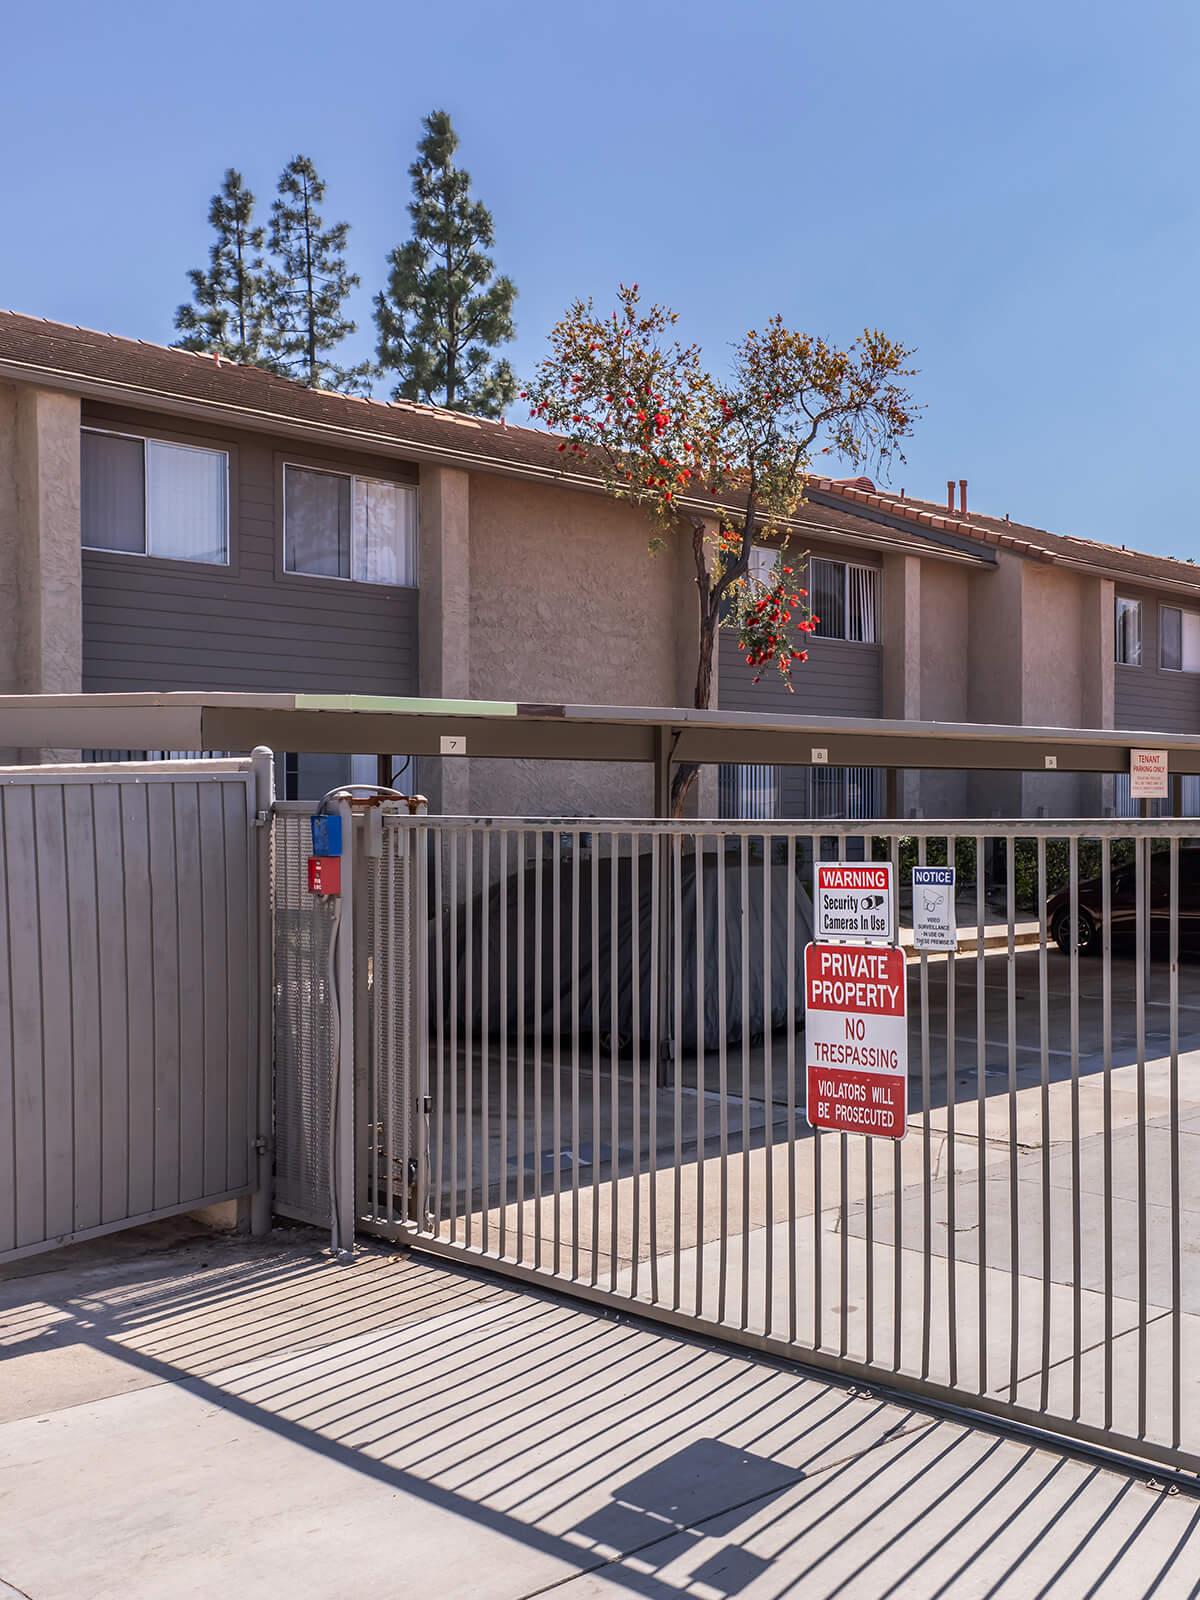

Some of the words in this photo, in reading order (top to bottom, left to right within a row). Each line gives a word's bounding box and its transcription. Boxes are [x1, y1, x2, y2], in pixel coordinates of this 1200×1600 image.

[450, 741, 456, 749] 7
[1139, 755, 1160, 763] TENANT
[822, 871, 886, 887] WARNING
[916, 871, 951, 883] NOTICE
[823, 894, 859, 914] Security
[823, 913, 859, 931] Cameras
[860, 915, 869, 930] In
[870, 916, 886, 932] Use
[821, 953, 889, 979] PRIVATE
[811, 980, 900, 1009] PROPERTY
[845, 1017, 866, 1041] NO
[814, 1042, 898, 1070] TRESPASSING
[818, 1079, 867, 1102] VIOLATORS
[871, 1086, 894, 1105] WILL
[817, 1102, 831, 1120] BE
[835, 1104, 895, 1129] PROSECUTED
